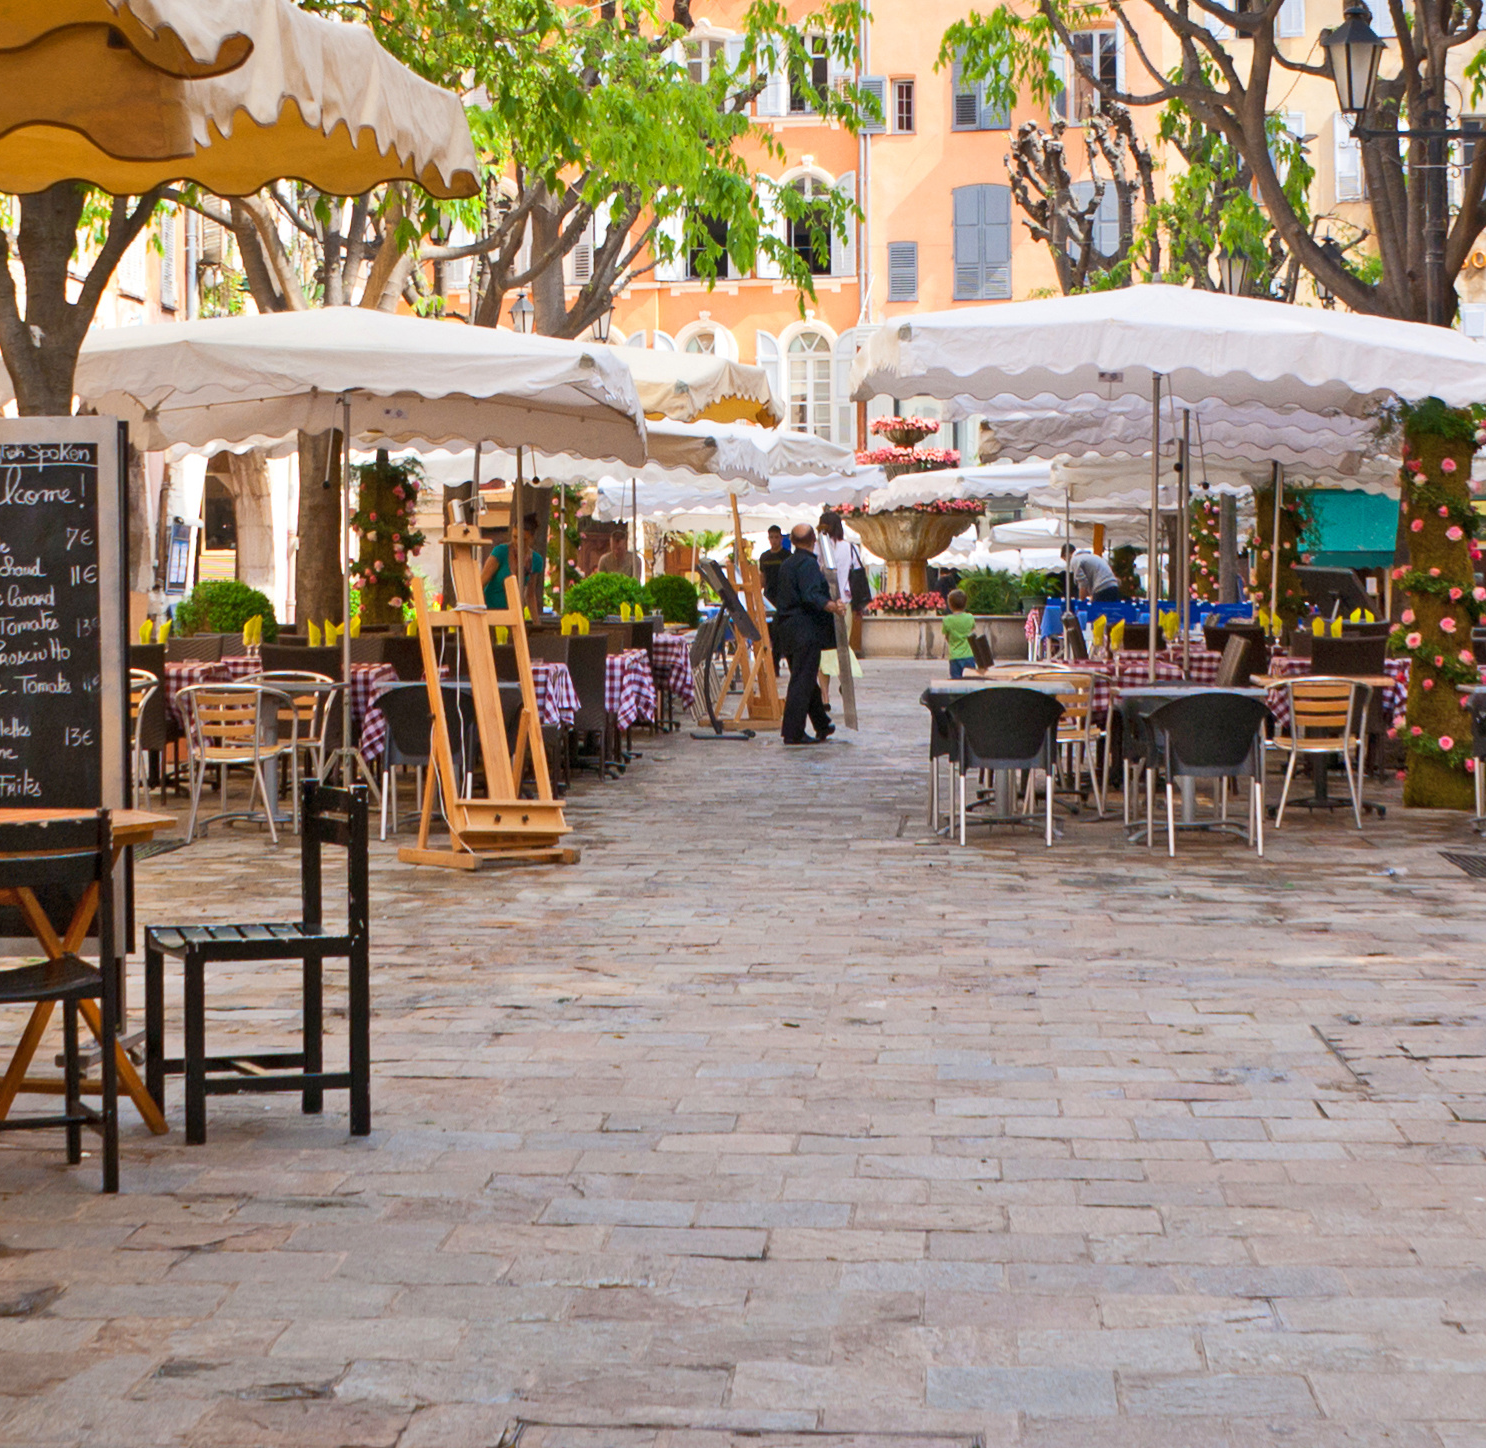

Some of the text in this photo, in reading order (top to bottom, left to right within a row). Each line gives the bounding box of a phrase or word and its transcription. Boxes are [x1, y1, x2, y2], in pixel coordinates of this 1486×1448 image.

[65, 527, 94, 551] 7€
[70, 563, 98, 587] 11€
[64, 726, 94, 747] 13€
